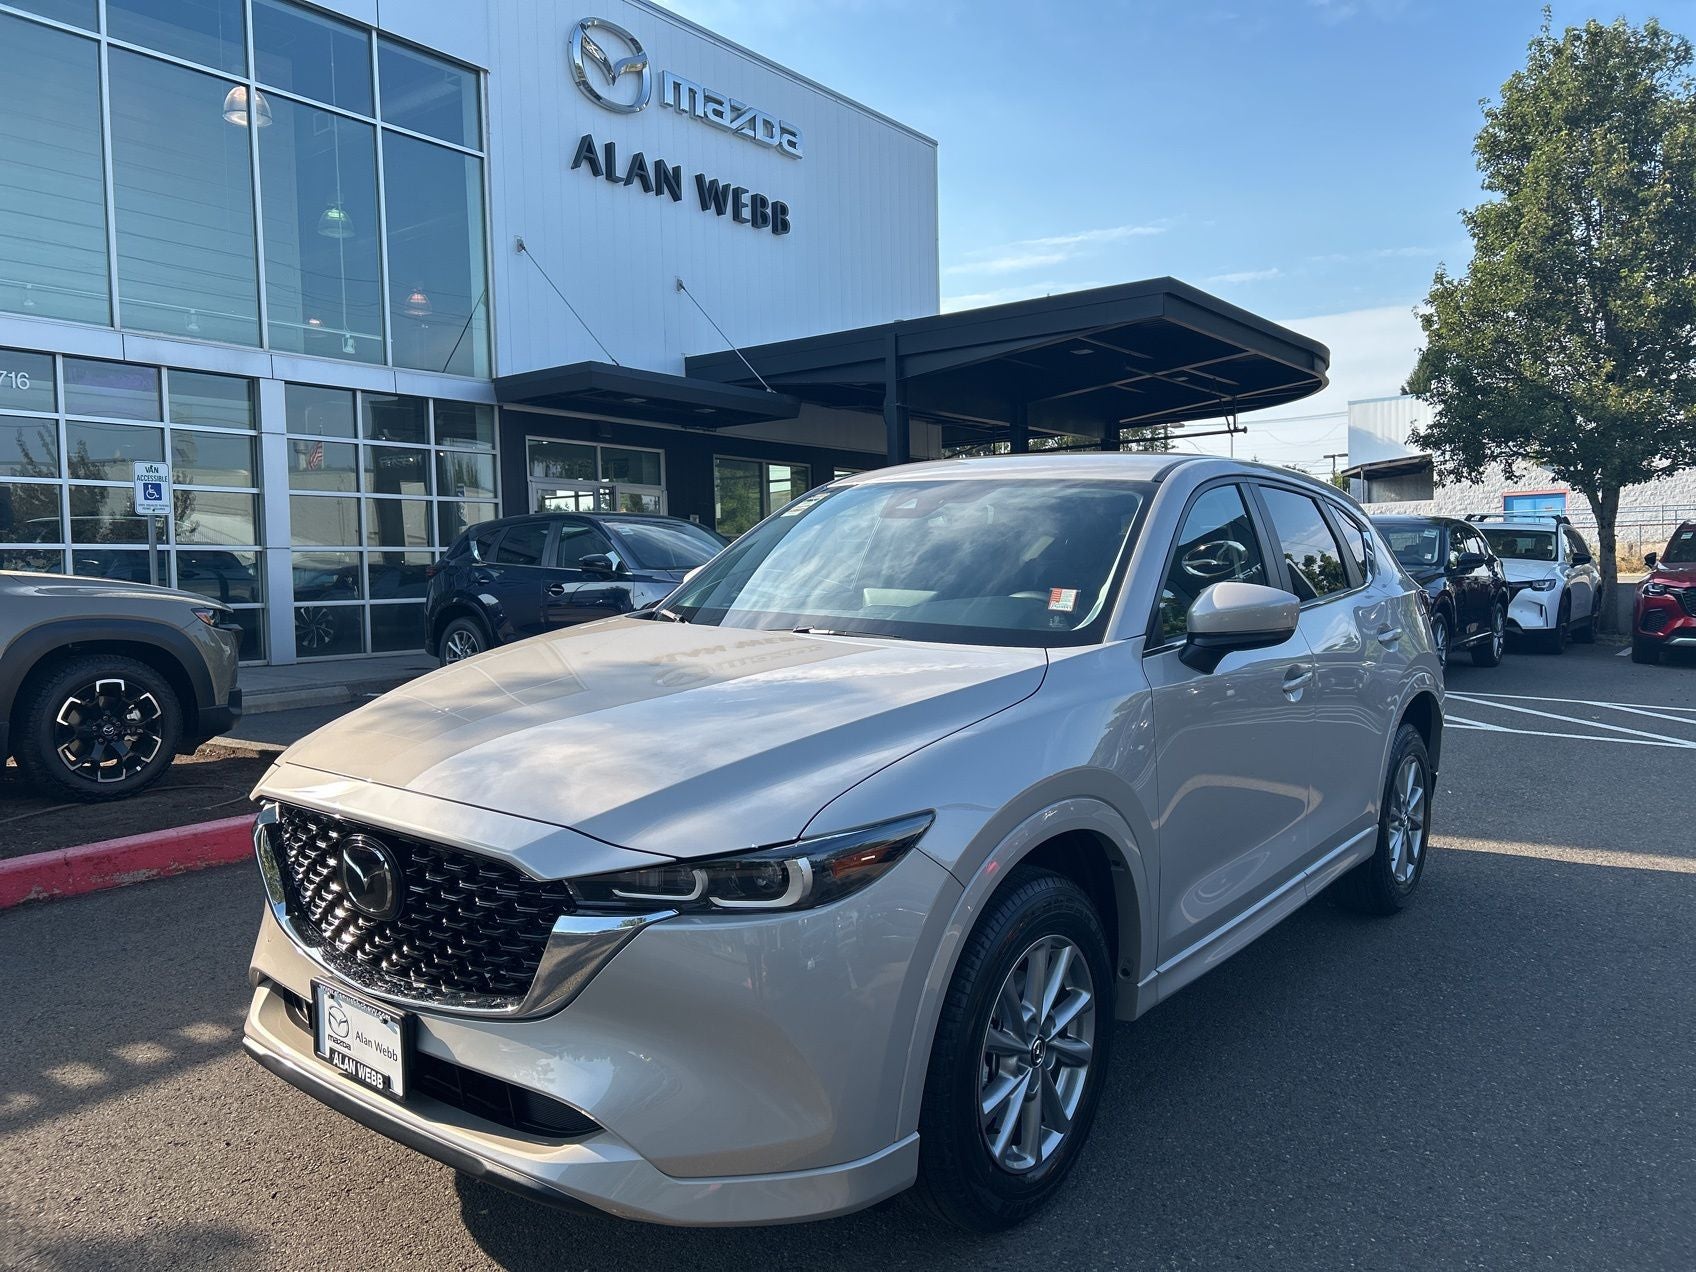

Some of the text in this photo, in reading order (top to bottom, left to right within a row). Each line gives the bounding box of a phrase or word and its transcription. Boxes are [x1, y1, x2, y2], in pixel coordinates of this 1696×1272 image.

[658, 70, 804, 159] mazda
[571, 134, 791, 235] ALAN WEBB
[0, 370, 30, 390] 716
[137, 475, 168, 483] ACCESSIBLE
[145, 466, 159, 474] VAN
[328, 1034, 351, 1051] mazda
[355, 1030, 398, 1062] Alan Webb
[333, 1051, 384, 1089] ALAN WEBB
